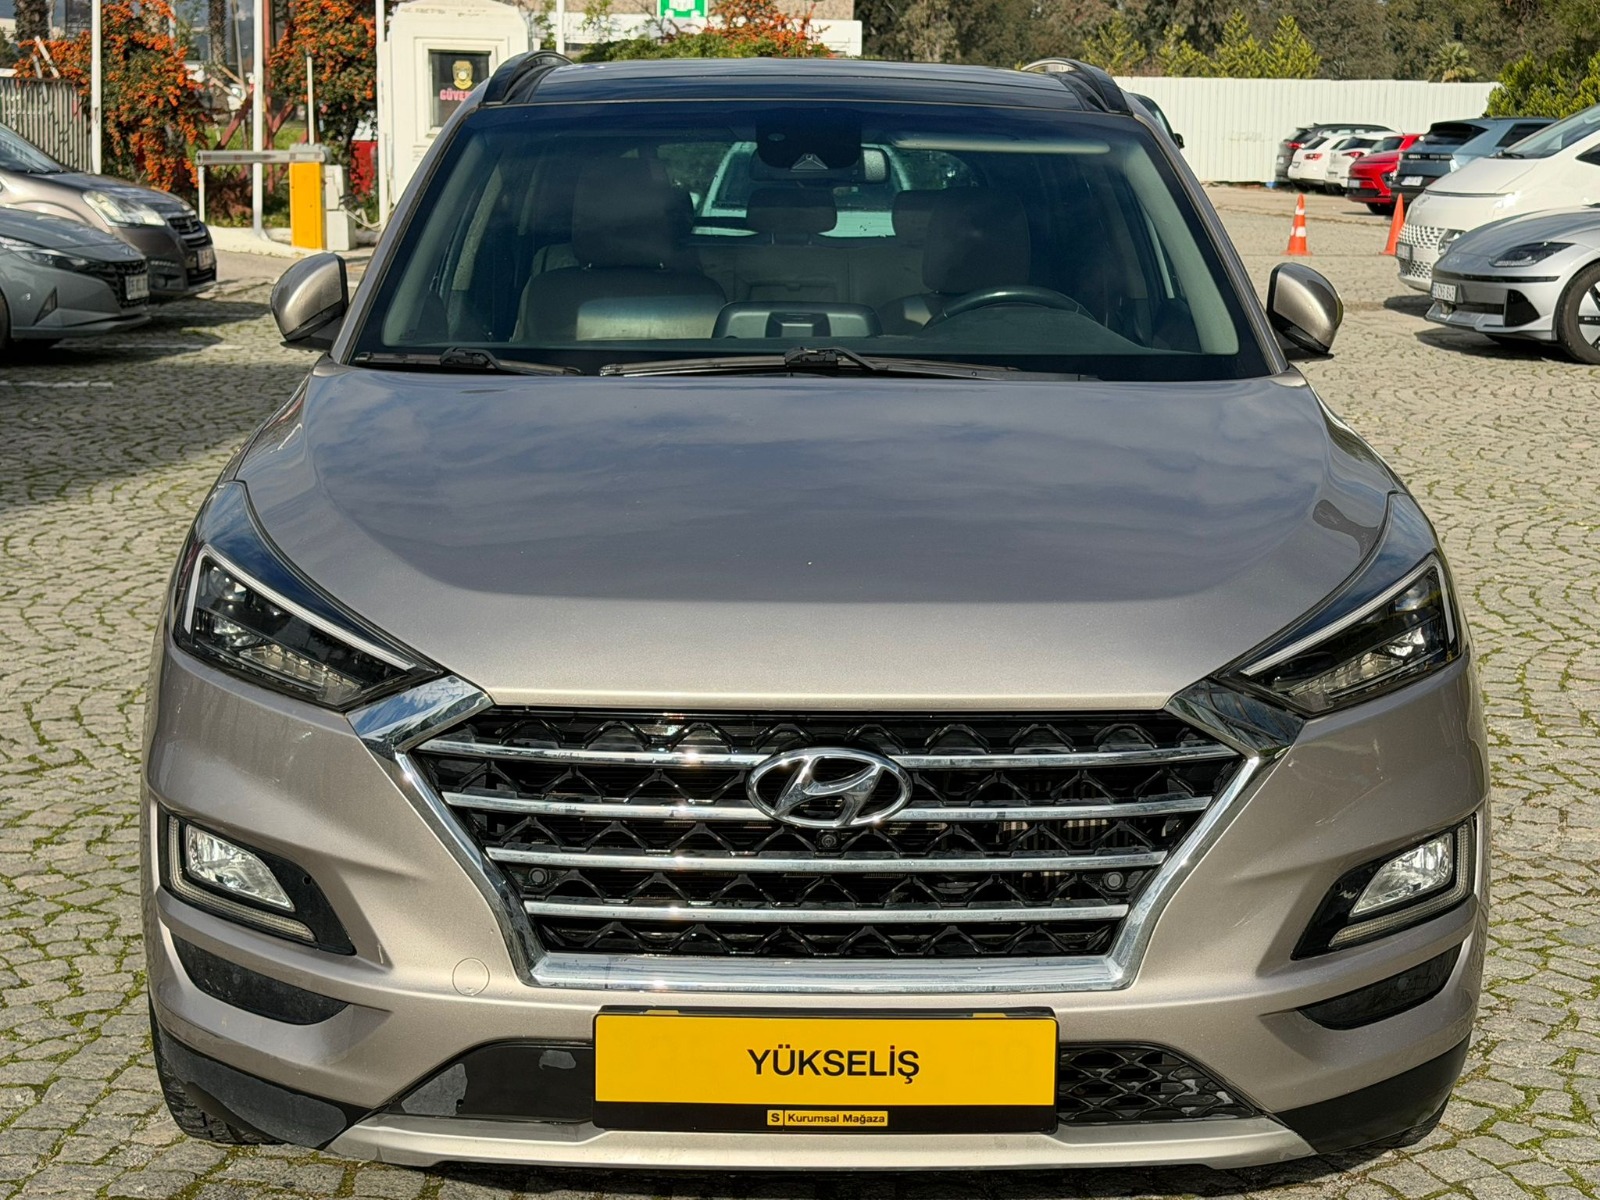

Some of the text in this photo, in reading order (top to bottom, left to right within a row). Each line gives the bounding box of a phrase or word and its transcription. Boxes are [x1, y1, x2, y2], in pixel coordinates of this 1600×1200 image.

[747, 1044, 920, 1085] YÜKSELİŞ
[771, 1113, 886, 1125] S Kurumsal Mağaza
